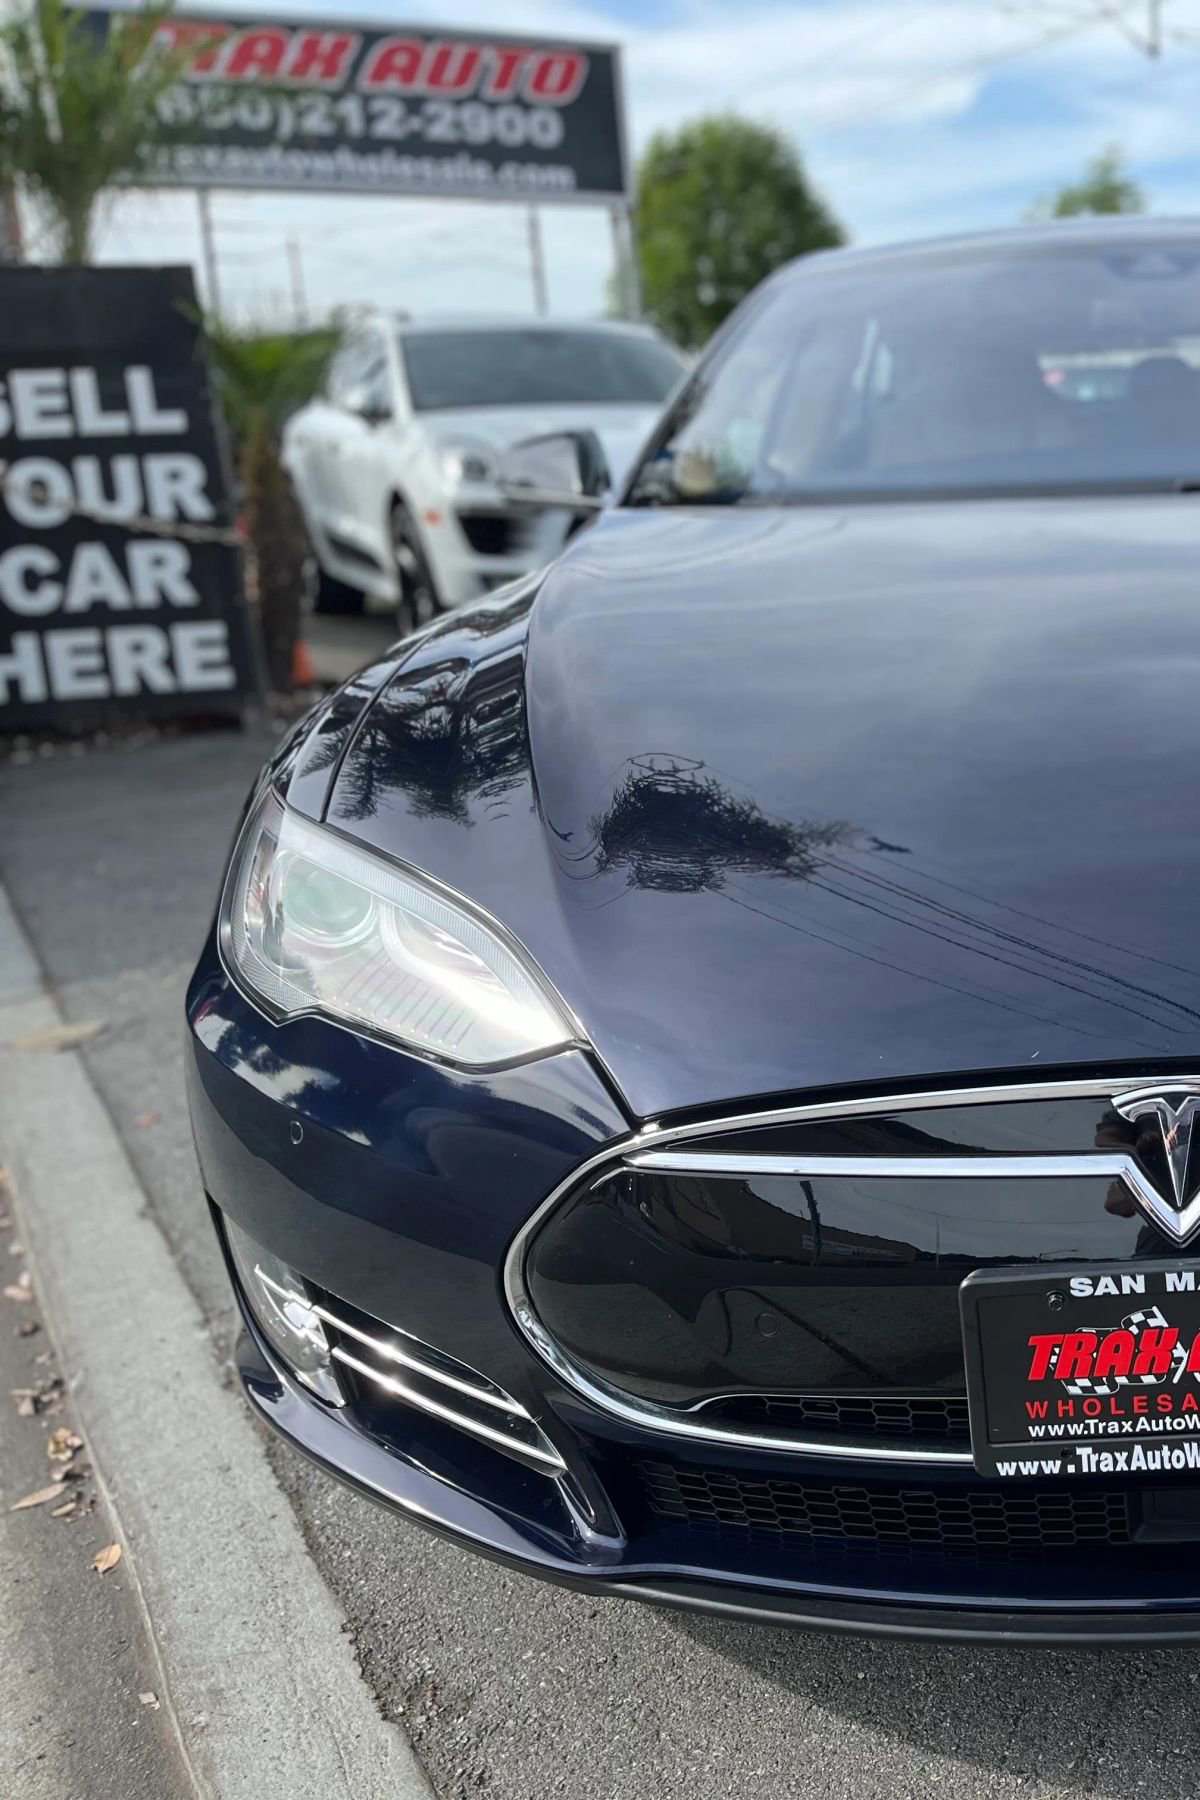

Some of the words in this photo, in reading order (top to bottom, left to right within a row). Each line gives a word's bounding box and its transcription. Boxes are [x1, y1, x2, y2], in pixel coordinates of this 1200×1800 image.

[358, 36, 588, 106] AUTO
[154, 84, 564, 149] 650)212-2900
[137, 143, 577, 190] raxautowholesale.com
[0, 365, 188, 439] ELL
[0, 453, 214, 529] OUR
[0, 539, 198, 616] CAR
[1070, 1274, 1146, 1297] SAN
[1027, 1327, 1179, 1381] TRAX
